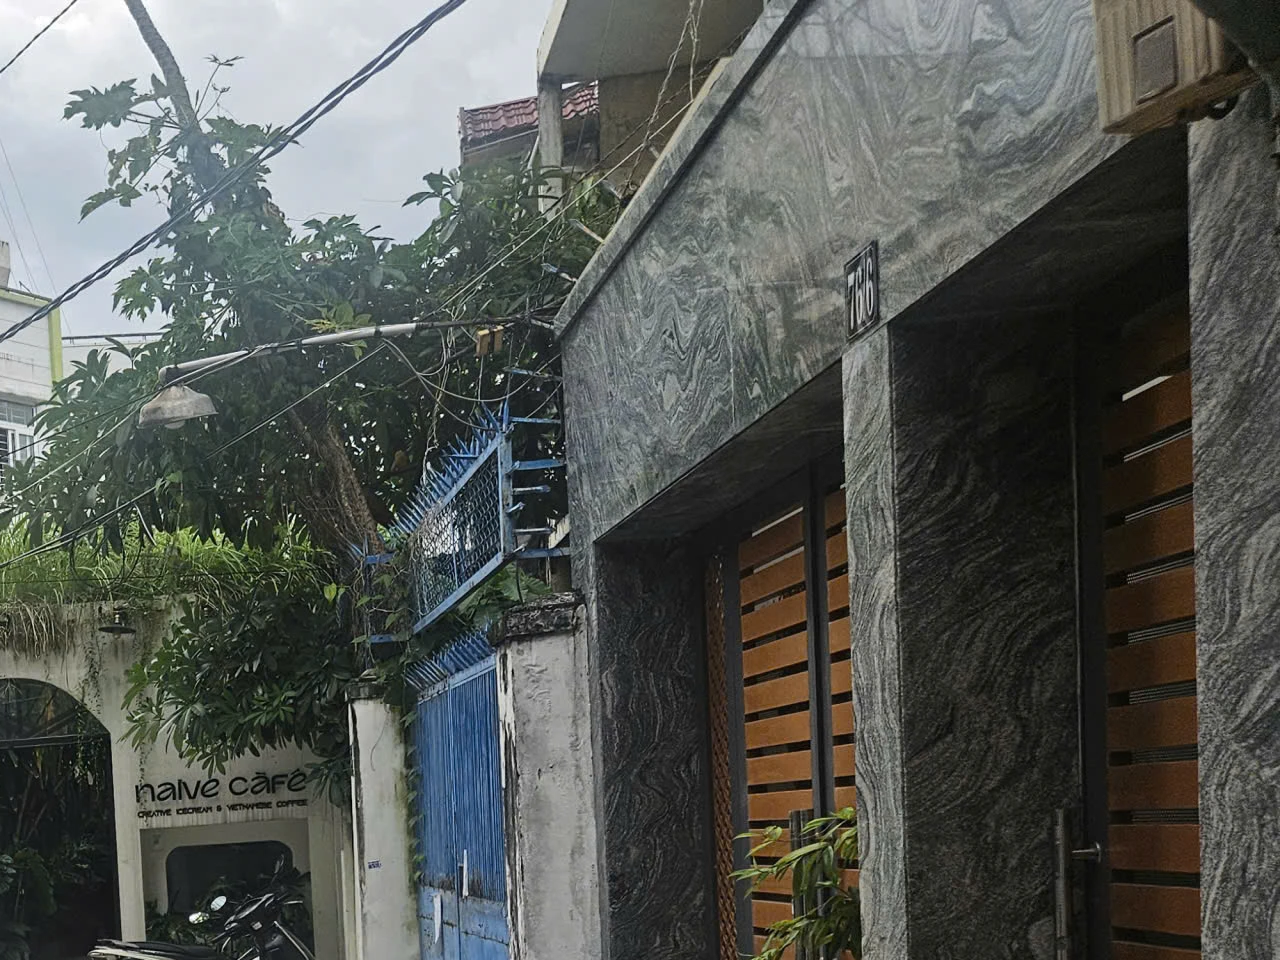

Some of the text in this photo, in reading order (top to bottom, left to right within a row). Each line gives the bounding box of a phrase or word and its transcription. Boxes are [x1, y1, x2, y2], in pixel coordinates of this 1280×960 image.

[137, 808, 172, 818] CREATIVE
[226, 801, 272, 811] VIETNAMESE
[276, 799, 308, 808] COFFEE
